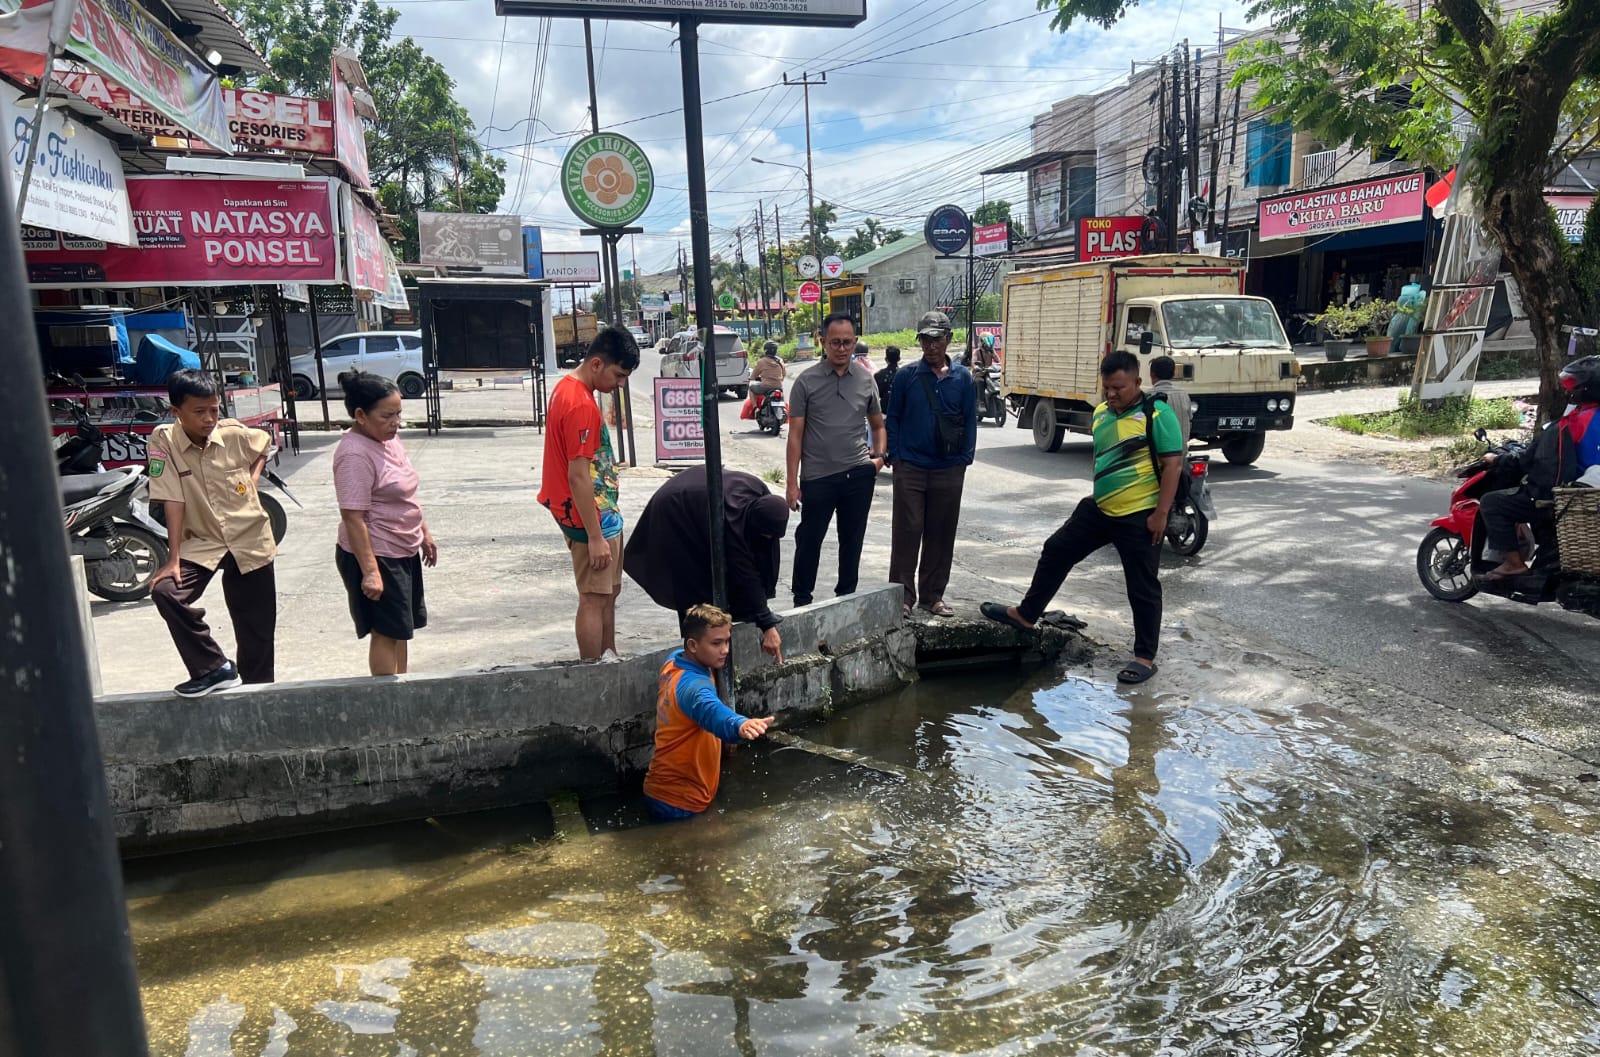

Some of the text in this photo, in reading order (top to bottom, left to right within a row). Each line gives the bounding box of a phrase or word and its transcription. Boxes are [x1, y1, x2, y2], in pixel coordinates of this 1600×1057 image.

[730, 1, 748, 9] Telp.
[48, 132, 114, 193] Fashionku
[598, 138, 634, 157] PHONE
[632, 158, 649, 184] CELL
[223, 198, 288, 207] Dapatkan di Sini
[1265, 178, 1420, 216] TOKO PLASTIK & BAHAN KUE
[190, 211, 326, 234] NATASYA
[1300, 208, 1337, 224] KITA
[1340, 199, 1386, 218] BARU
[1087, 220, 1112, 229] TOKO
[1308, 221, 1331, 231] GROSIR
[1336, 217, 1361, 227] ECERAN
[204, 240, 320, 263] PONSEL
